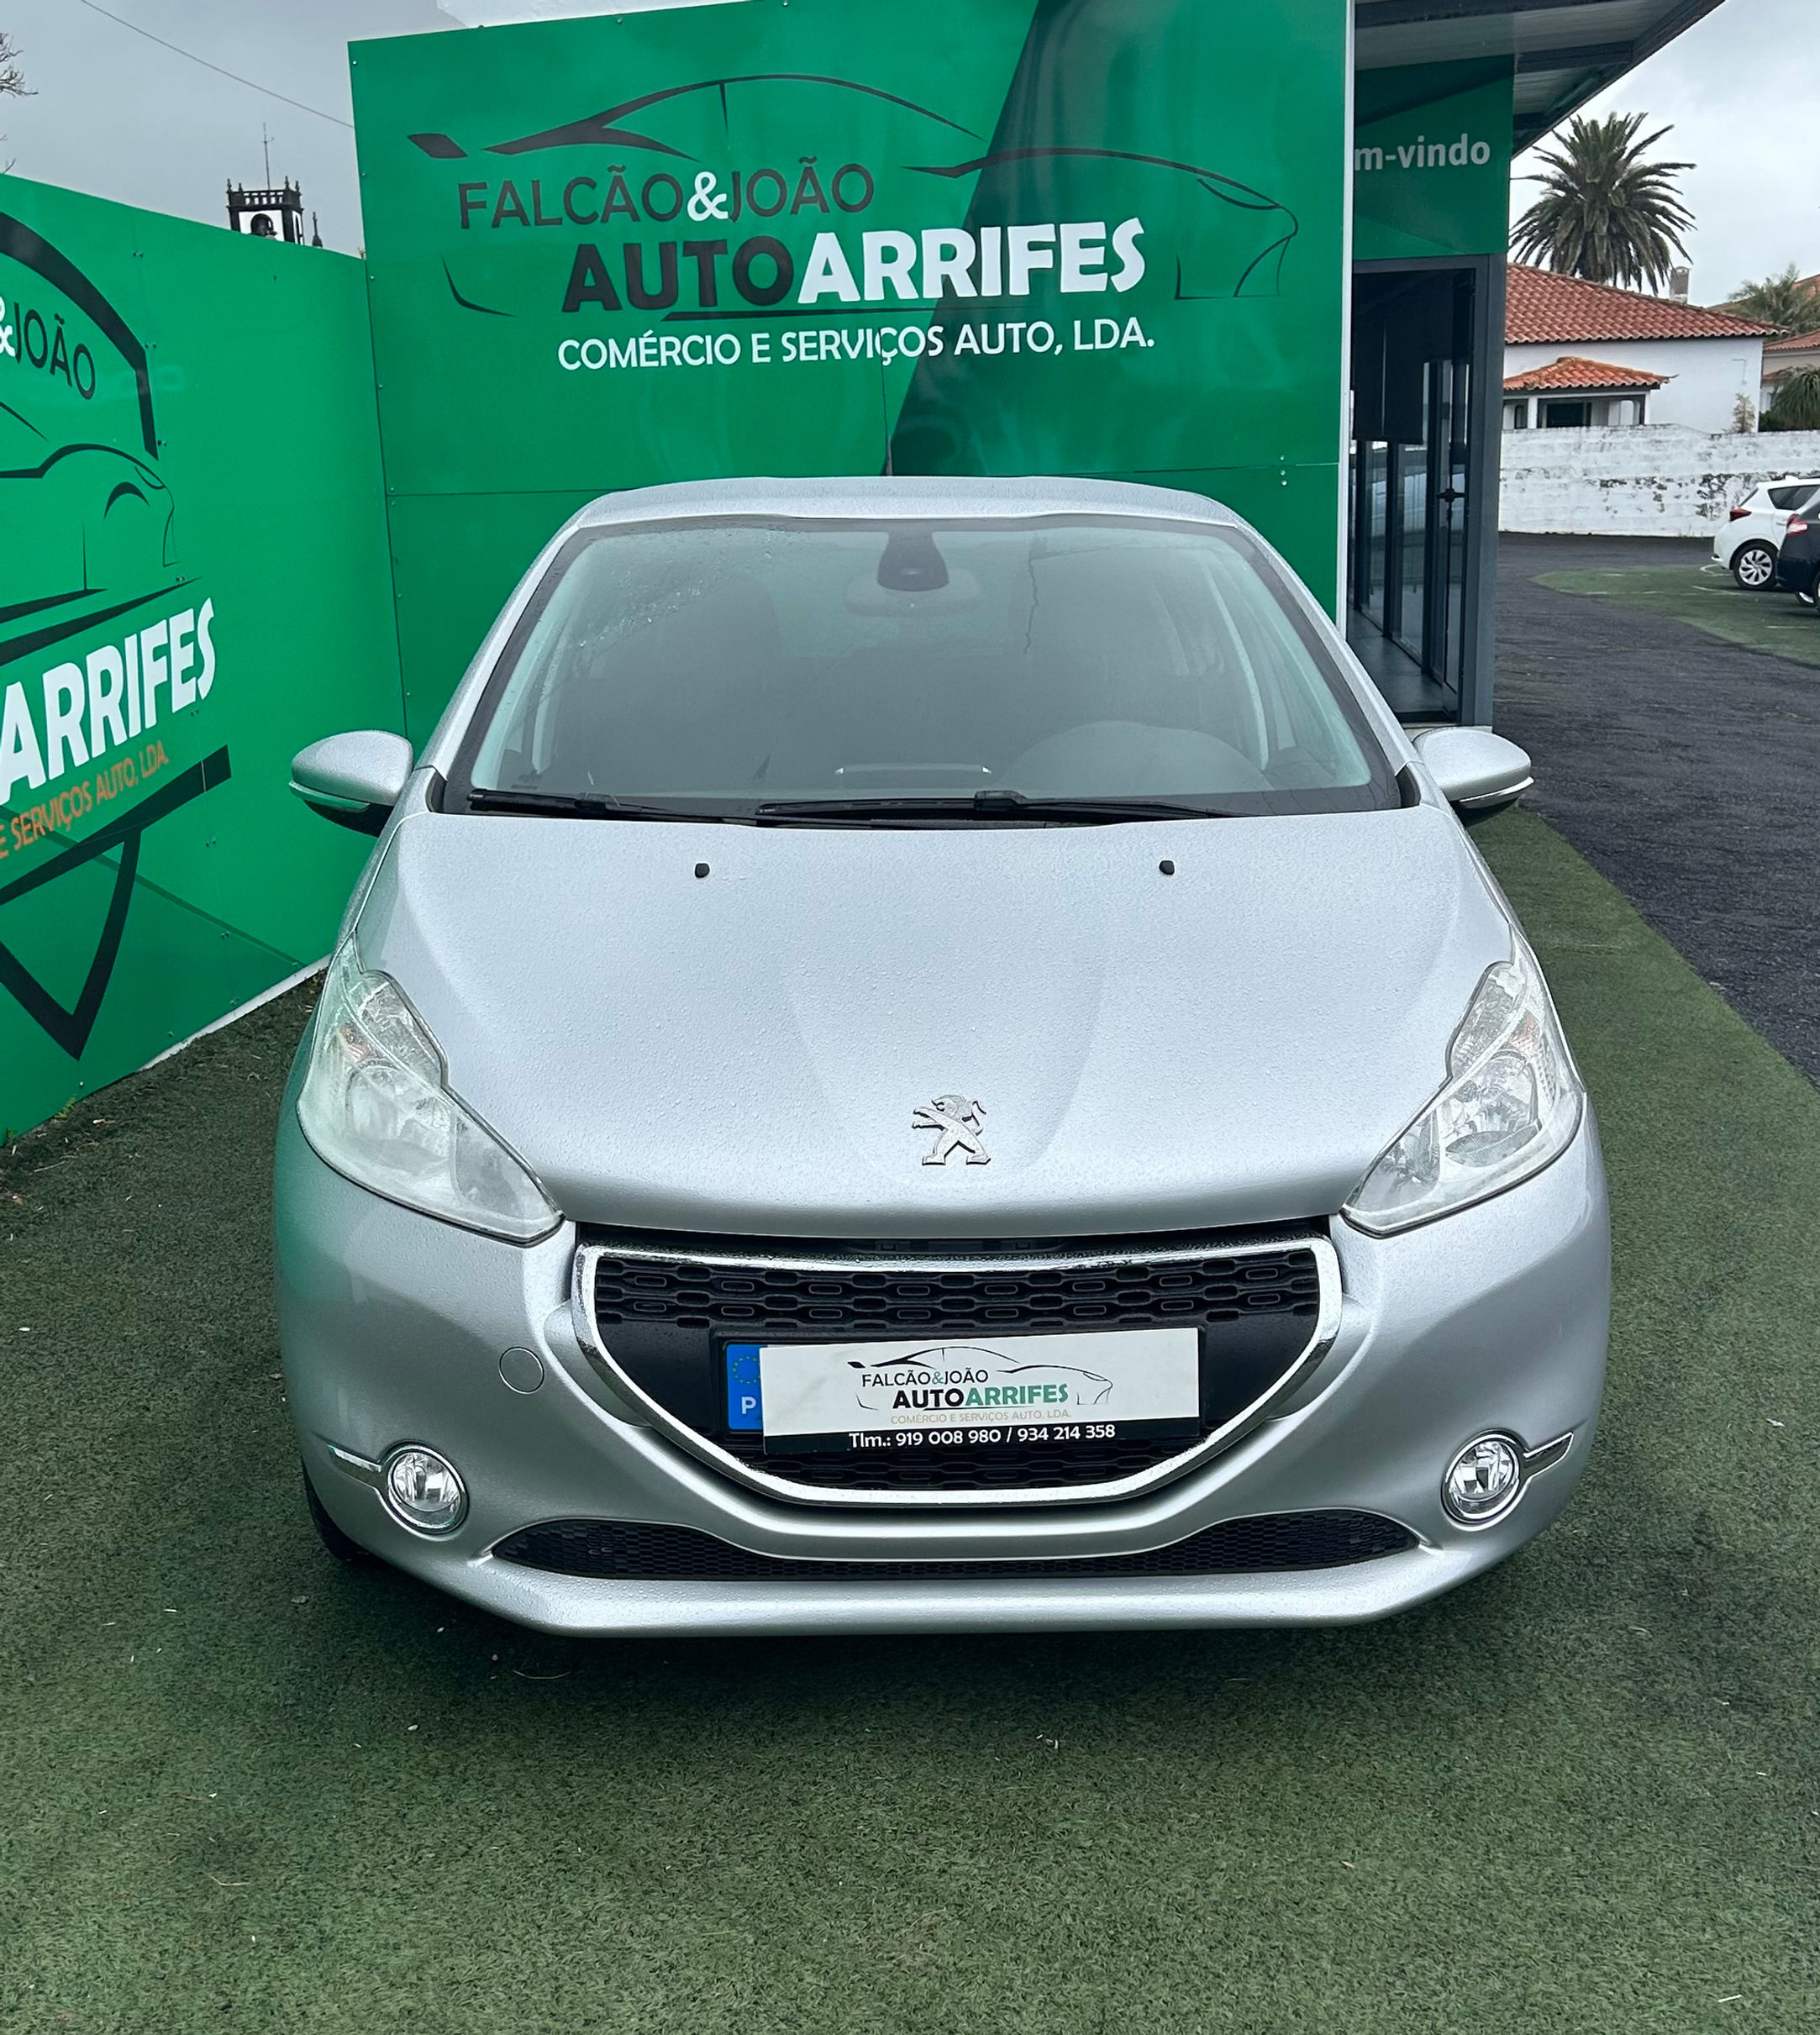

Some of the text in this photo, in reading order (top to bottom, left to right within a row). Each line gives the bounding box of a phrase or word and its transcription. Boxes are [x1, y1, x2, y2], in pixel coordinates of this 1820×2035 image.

[1354, 133, 1491, 171] m-vindo
[458, 156, 875, 229] FALCÃO&JOÃO
[561, 217, 1146, 313] AUTOARRIFES
[558, 316, 1155, 371] COMÉRCIO E SERVIÇOS AUTO, LDA.
[0, 597, 216, 806] ARRIFES
[11, 781, 92, 851] SERVIÇOS
[96, 757, 139, 806] AUTO,
[862, 1367, 989, 1387] FALCÃO&JOÃO
[892, 1383, 1069, 1409] AUTOARRIFES
[741, 1396, 757, 1415] P
[891, 1413, 948, 1425] COMÉRCIO
[950, 1414, 957, 1422] E
[960, 1411, 1009, 1422] SERVIÇOS
[1047, 1409, 1072, 1418] LDA.
[849, 1424, 1116, 1448] Tlm.: 919 008 980 / 934 214 358
